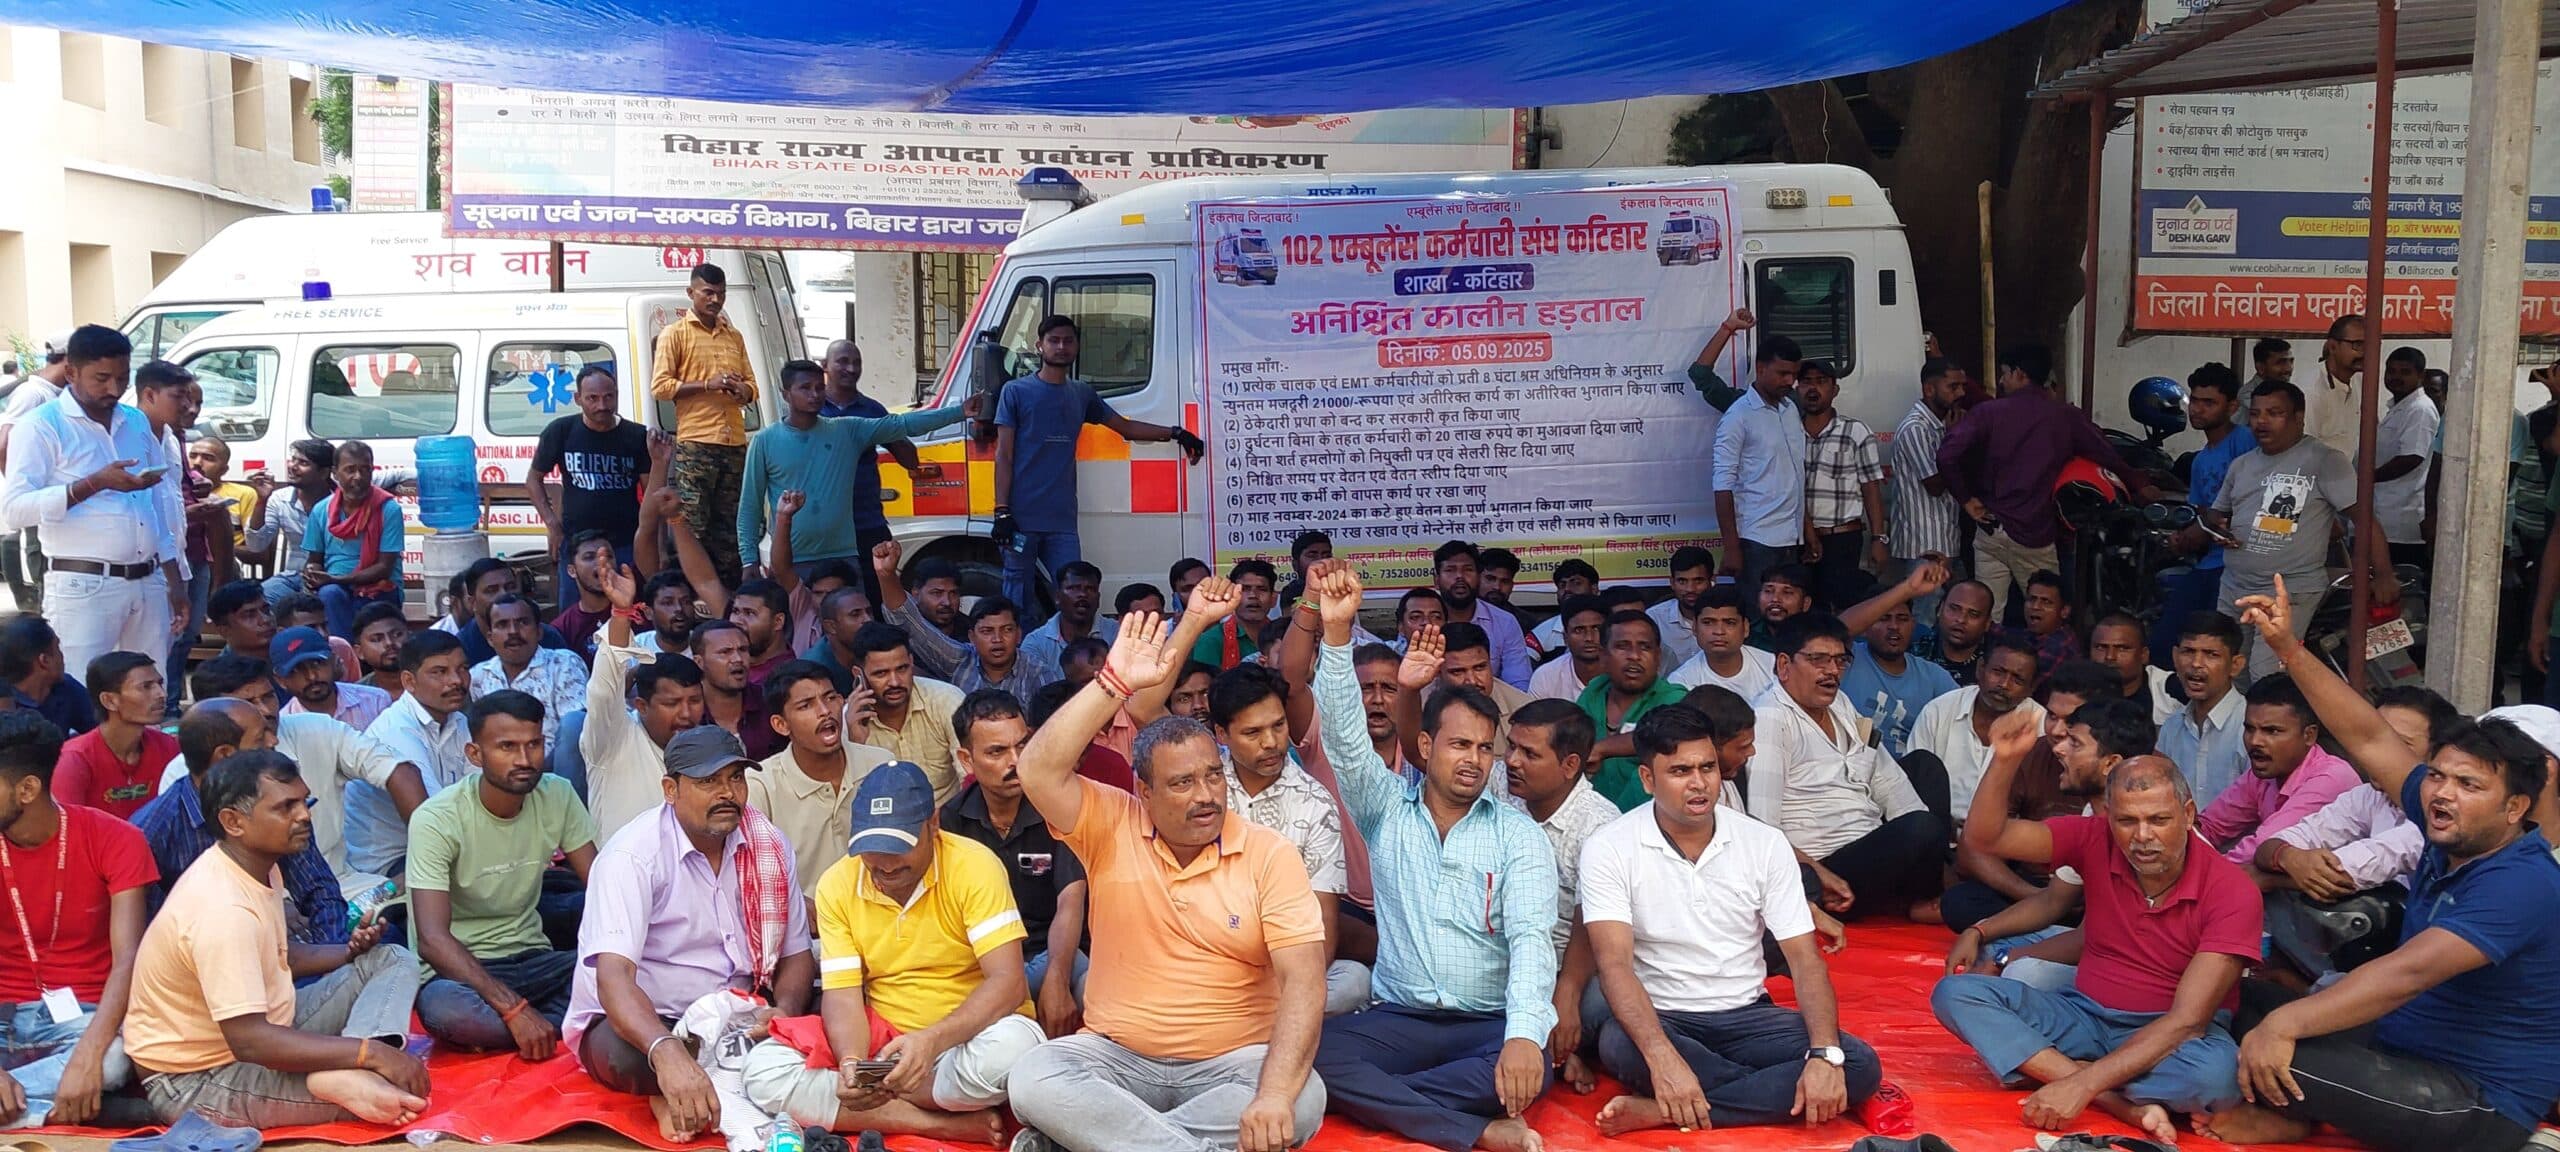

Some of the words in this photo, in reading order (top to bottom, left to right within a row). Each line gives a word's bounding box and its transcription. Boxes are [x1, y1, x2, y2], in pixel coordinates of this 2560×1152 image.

[2169, 102, 2186, 115] सेवा
[2190, 107, 2218, 117] पहचान
[2222, 107, 2235, 115] पत्र
[2403, 101, 2438, 113] दस्तावेज
[679, 111, 701, 123] लिए
[2221, 124, 2233, 136] की
[2236, 124, 2273, 140] फोटोयुक्त
[2277, 128, 2308, 141] पासबुक
[2201, 144, 2220, 157] बीमा
[2224, 144, 2244, 157] स्मार्ट
[2248, 144, 2267, 158] कार्ड
[2438, 137, 2448, 149] को
[660, 134, 763, 156] बिहार
[776, 140, 867, 160] राज्य
[883, 143, 1004, 163] आपदा
[1016, 144, 1135, 167] प्रबंधन
[1148, 146, 1328, 170] प्राधिकरण
[713, 158, 779, 169] BIHAR
[787, 160, 856, 171] STATE
[864, 163, 970, 176] DISASTER
[2425, 156, 2453, 167] पहचान
[2203, 165, 2235, 178] लाइसेंस
[2405, 176, 2421, 186] जॉब
[2426, 174, 2444, 186] कार्ड
[1446, 203, 1462, 215] संघ
[2429, 199, 2443, 216] हेतु
[2531, 203, 2542, 214] या
[462, 204, 539, 229] सूचना
[543, 200, 582, 223] एवं
[587, 204, 737, 225] जन-सम्पर्क
[745, 204, 837, 231] विभाग,
[845, 208, 919, 232] बिहार
[921, 213, 972, 235] द्वारा
[2156, 217, 2190, 236] चुनाव
[2193, 218, 2210, 231] का
[2214, 215, 2234, 232] पर्व
[2298, 219, 2328, 233] Voter
[370, 236, 391, 245] Free
[394, 236, 429, 245] Service
[1282, 234, 1323, 266] 102
[1423, 217, 1515, 260] कर्मचारी
[1519, 217, 1560, 255] संघ
[1564, 214, 1648, 252] कटिहार
[2169, 234, 2191, 243] DESH
[2192, 234, 2205, 243] KA
[2206, 234, 2231, 243] GARV
[411, 253, 476, 281] शव
[2334, 264, 2361, 274] Follow
[1404, 275, 1448, 292] शाखा
[1464, 267, 1524, 289] कटिहार
[2147, 282, 2208, 318] जिला
[2212, 281, 2300, 318] निर्वाचन
[318, 308, 384, 318] SERVICE
[1291, 301, 1414, 336] अनिश्चित
[1422, 295, 1528, 329] कालीन
[1534, 297, 1645, 332] हड़ताल
[1386, 341, 1446, 364] दिनांक:
[1451, 342, 1545, 361] 05.09.2025
[1221, 362, 1253, 378] प्रमुख
[1242, 377, 1276, 394] प्रत्येक
[1280, 379, 1316, 391] चालक
[1320, 376, 1337, 390] एवं
[1342, 377, 1369, 389] EMT
[1374, 371, 1435, 388] कर्मचारीयों
[1439, 370, 1454, 386] को
[1543, 364, 1600, 380] अधिनियम
[1620, 364, 1664, 379] अनुसार
[1268, 395, 1309, 414] मजदूरी
[1581, 384, 1623, 402] भुगतान
[1627, 381, 1657, 397] किया
[1244, 413, 1290, 430] ठेकेदारी
[1294, 415, 1316, 428] प्रथा
[1320, 412, 1336, 427] को
[1366, 413, 1386, 426] कर
[1389, 408, 1435, 424] सरकारी
[1463, 406, 1493, 421] किया
[1497, 407, 1520, 422] जाए
[1365, 428, 1411, 444] कर्मचारी
[1436, 431, 1450, 441] 20
[1536, 423, 1586, 441] मुआवजा
[1590, 420, 1616, 436] दिया
[477, 446, 513, 458] NATIONAL
[1300, 448, 1346, 466] हमलोगों
[1350, 447, 1366, 463] को
[1437, 445, 1454, 461] एवं
[1521, 442, 1547, 457] दिया
[1551, 443, 1575, 457] जाए
[565, 452, 617, 473] BELIEVE
[572, 473, 632, 490] YOURSELF
[1287, 471, 1316, 485] समय
[1340, 466, 1366, 483] वेतन
[1390, 464, 1417, 480] वेतन
[1455, 464, 1480, 479] दिया
[1247, 490, 1277, 506] हटाए
[1301, 487, 1328, 504] कर्मी
[1332, 486, 1347, 502] को
[1351, 489, 1383, 501] वापस
[1388, 484, 1412, 499] कार्य
[1416, 502, 1442, 516] वेतन
[1490, 501, 1532, 518] भुगतान
[1536, 498, 1565, 513] किया
[1248, 530, 1270, 542] 102
[1566, 516, 1595, 529] समय
[1614, 512, 1643, 527] किया
[1380, 568, 1434, 579] 735280084
